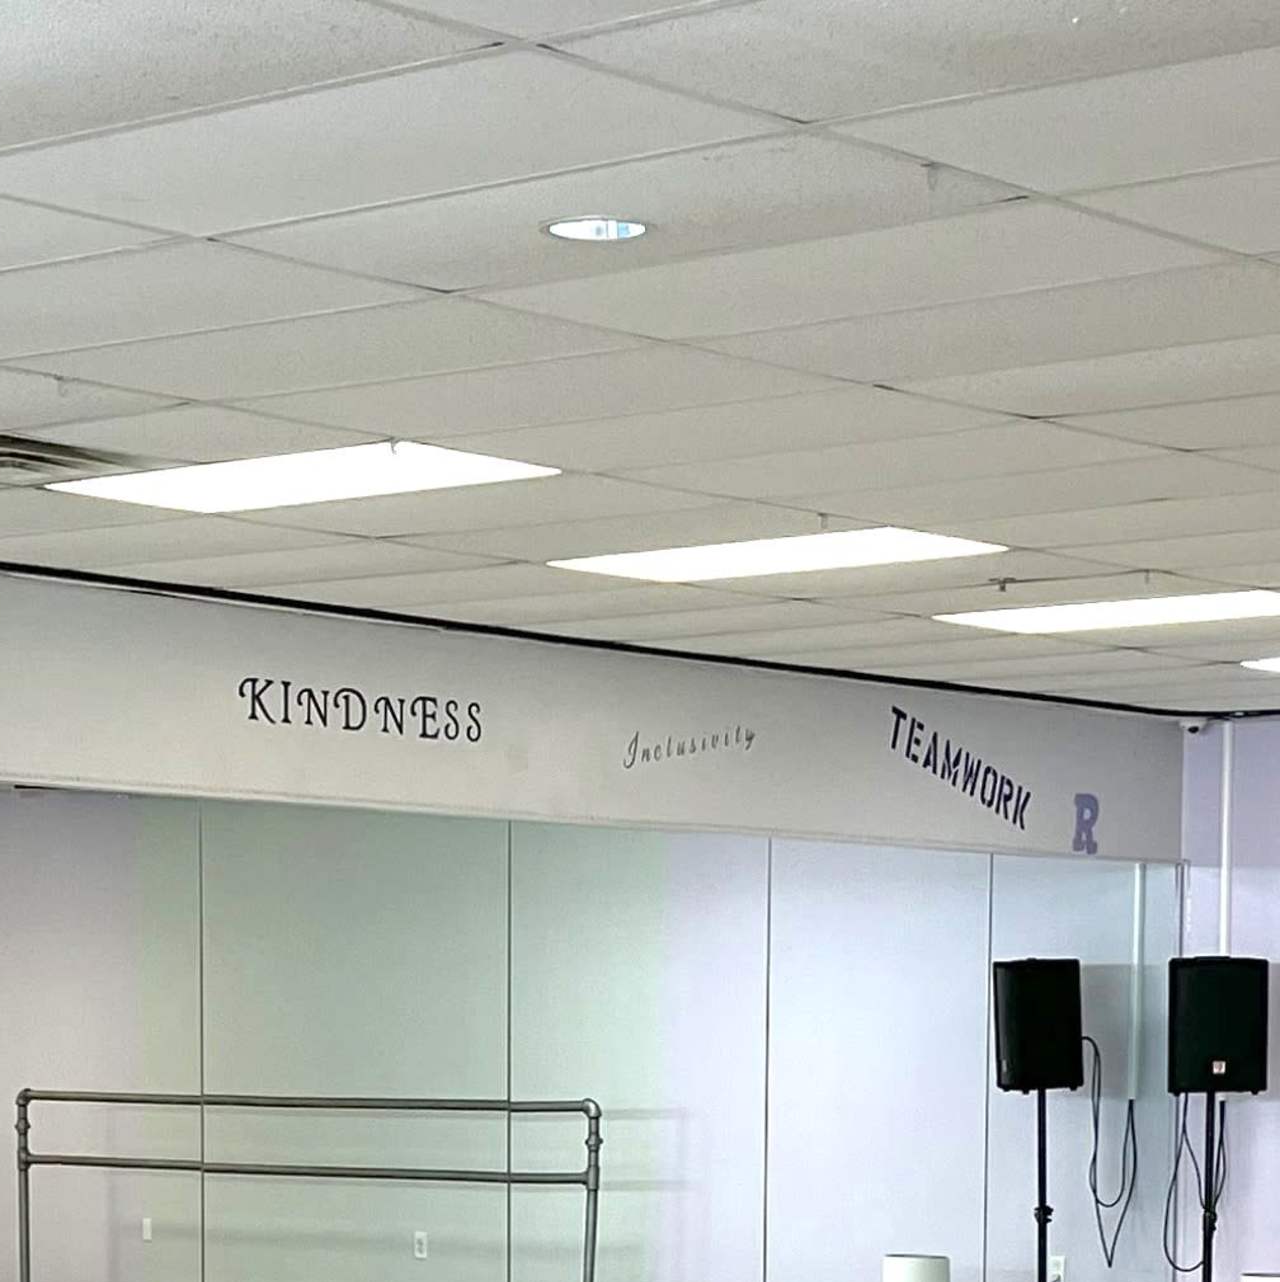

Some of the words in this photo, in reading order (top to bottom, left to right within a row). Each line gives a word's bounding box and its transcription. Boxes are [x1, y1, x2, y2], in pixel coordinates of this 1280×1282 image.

[237, 676, 484, 744] KINDNESS
[622, 724, 756, 770] Inclusivity
[888, 704, 1033, 832] TEAMWORK
[1071, 792, 1101, 856] R
